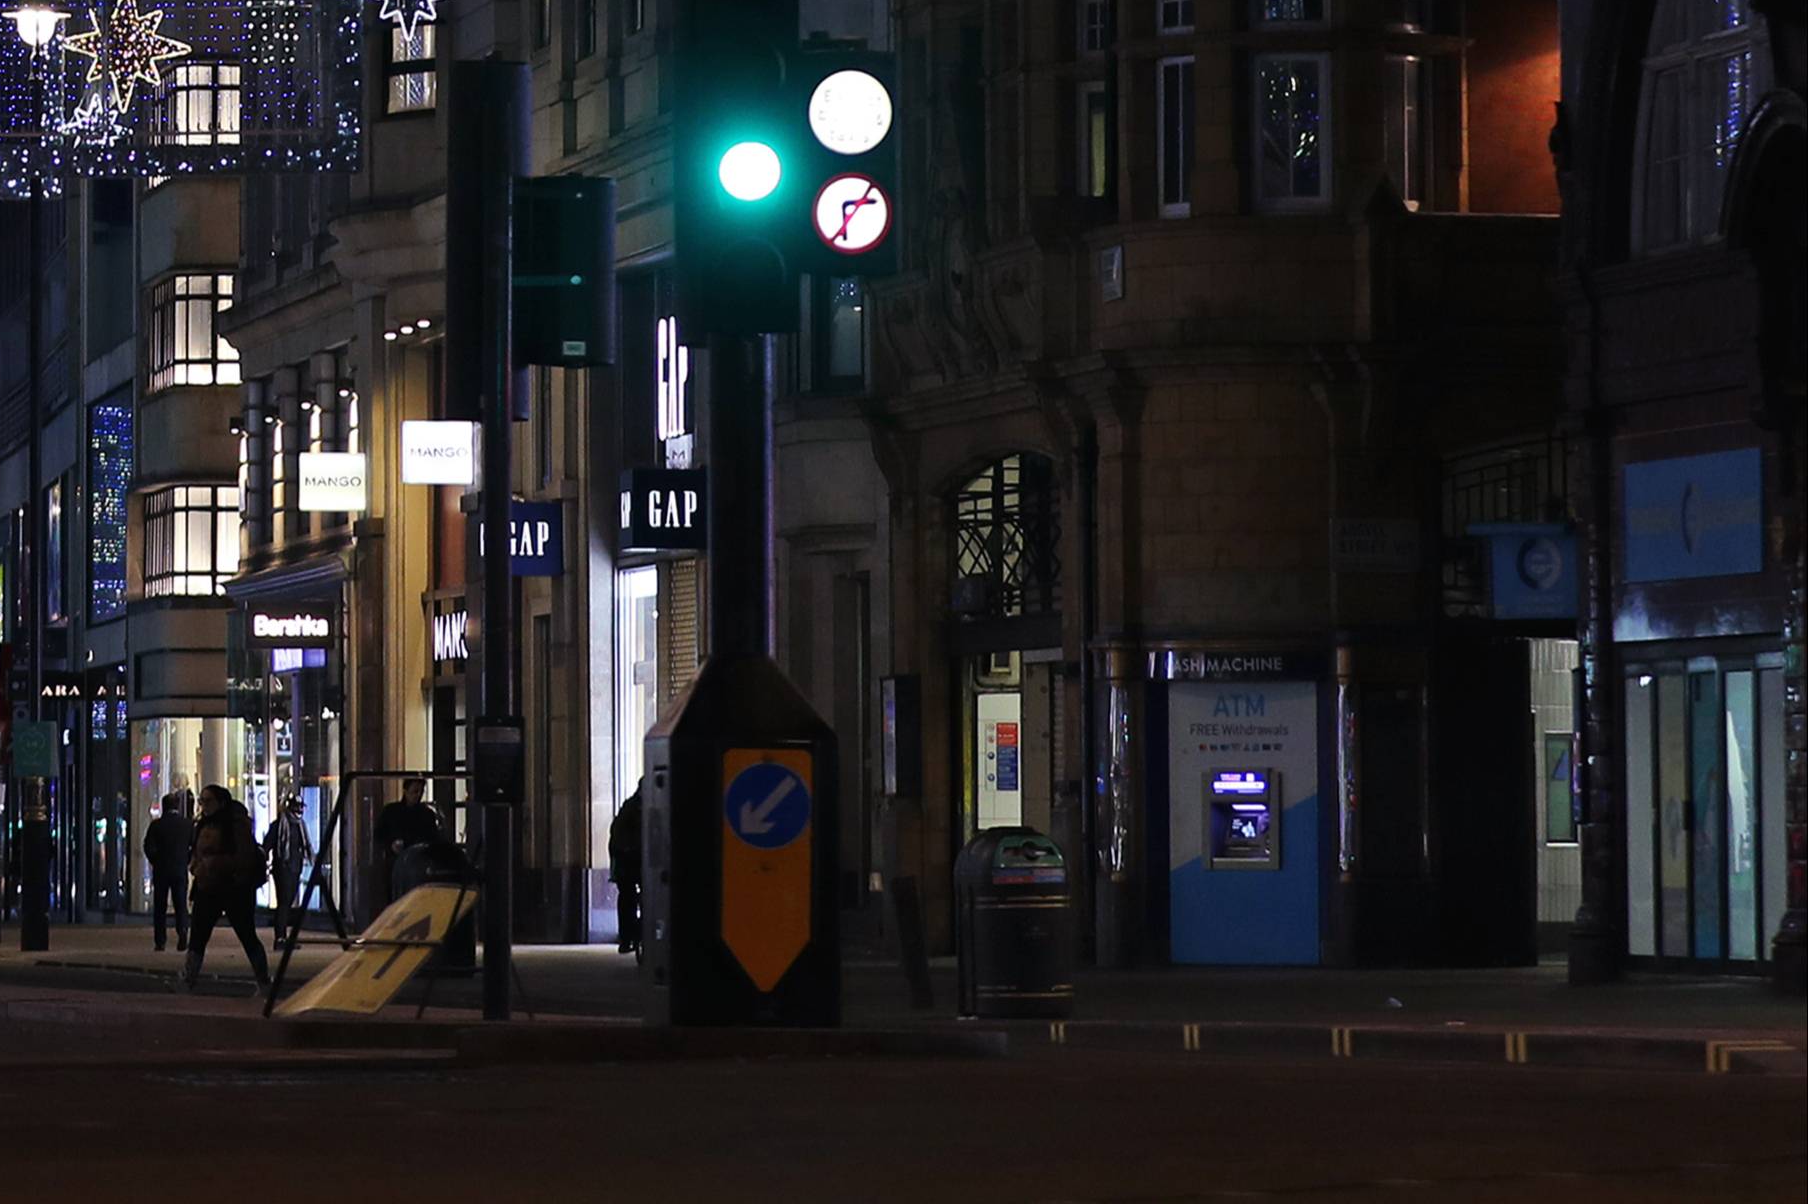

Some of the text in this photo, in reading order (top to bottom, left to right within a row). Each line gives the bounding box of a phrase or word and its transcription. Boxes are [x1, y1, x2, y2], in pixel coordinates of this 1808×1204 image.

[409, 447, 468, 458] MANGO
[304, 475, 362, 487] MANGO
[648, 489, 698, 529] GAP
[253, 614, 329, 637] Bershka
[434, 610, 468, 662] MAN
[1206, 657, 1283, 671] MACHINE
[41, 684, 80, 697] ARA
[1212, 694, 1266, 717] ATM
[1190, 723, 1289, 736] FREE Withdrawals
